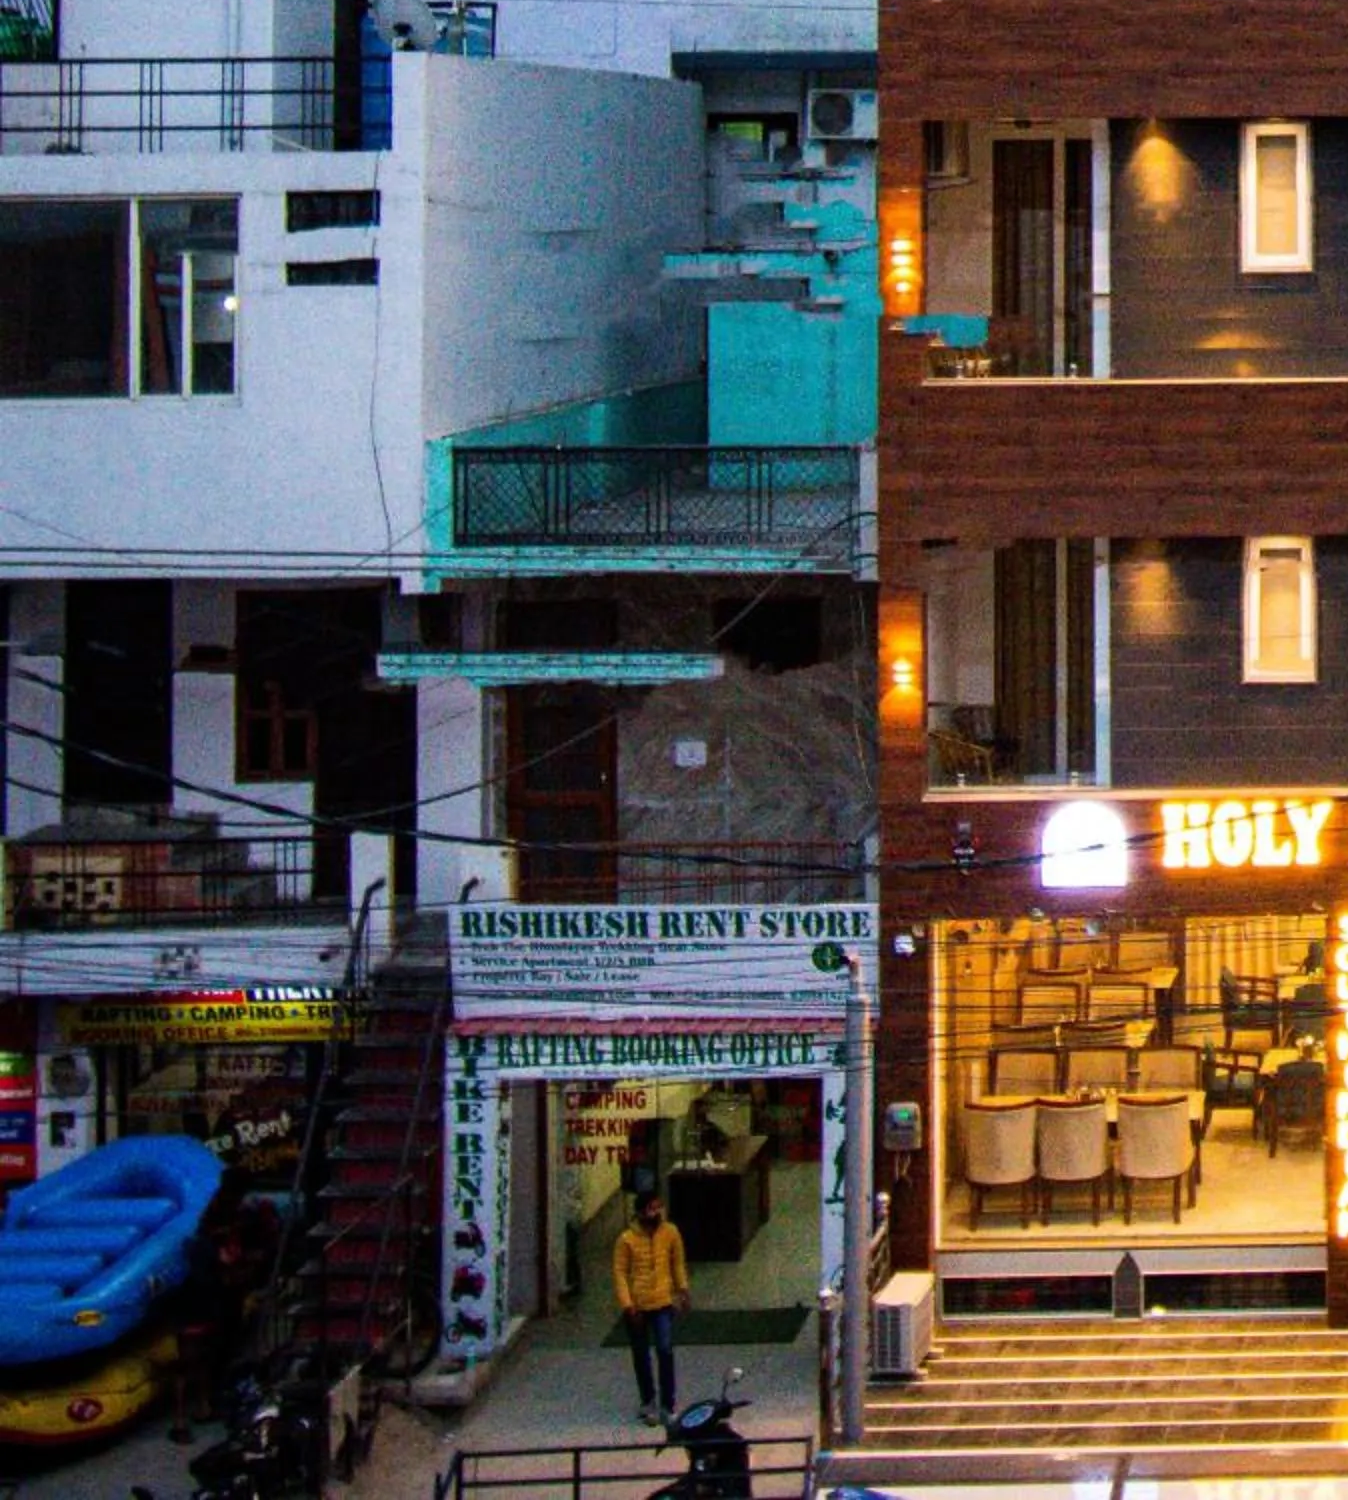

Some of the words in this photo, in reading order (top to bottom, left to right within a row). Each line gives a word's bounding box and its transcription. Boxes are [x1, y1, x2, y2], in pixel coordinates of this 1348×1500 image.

[1162, 801, 1332, 867] HOLY
[460, 910, 652, 938] RISHIKESH
[659, 910, 751, 938] RENT
[758, 909, 872, 938] STORE
[190, 1005, 286, 1023] CAMPING
[497, 1033, 602, 1068] RAFTING
[611, 1033, 722, 1067] BOOKING
[730, 1033, 816, 1066] OFFICE
[564, 1145, 598, 1165] DAY
